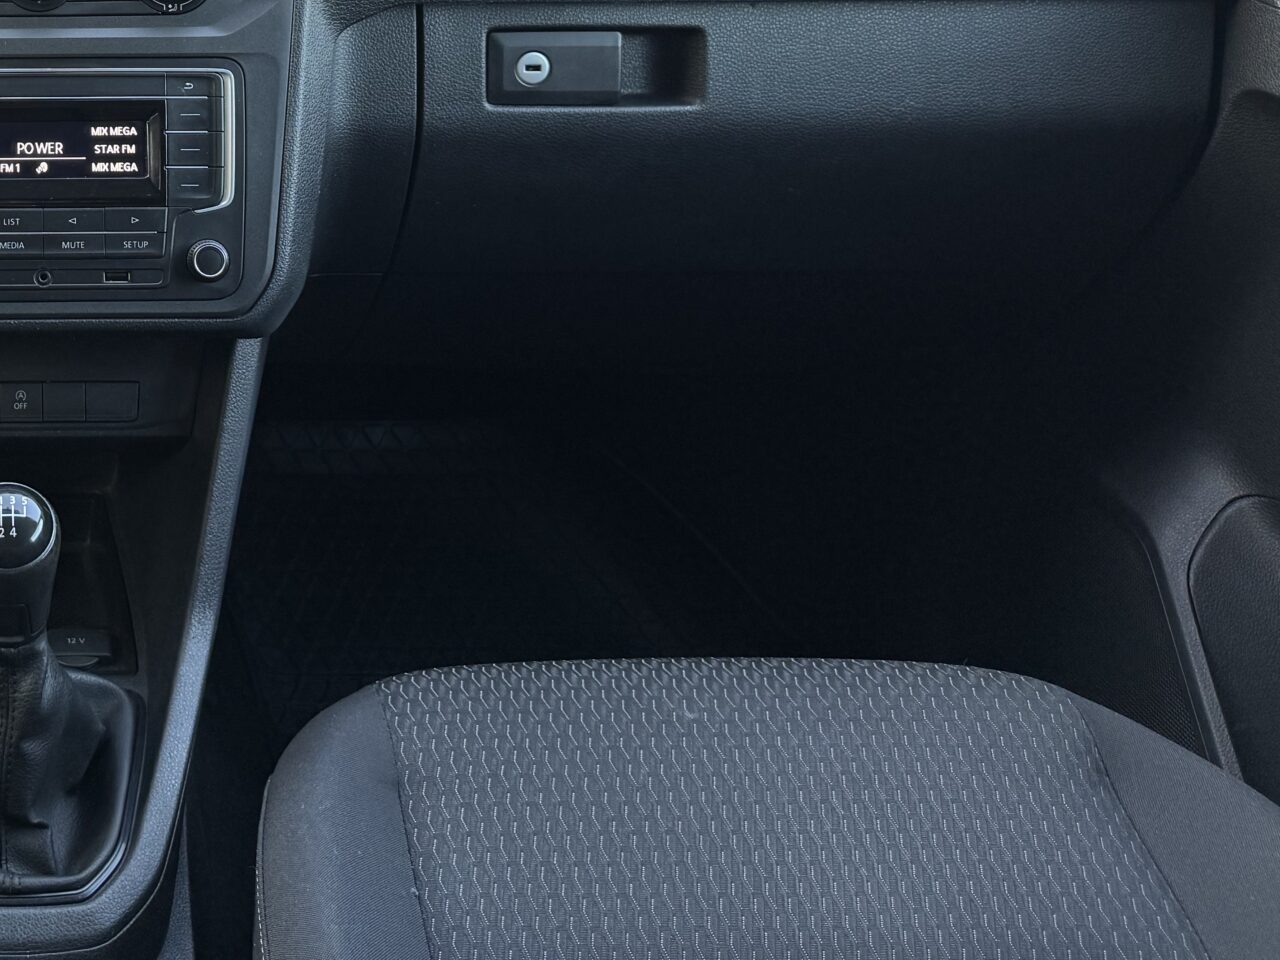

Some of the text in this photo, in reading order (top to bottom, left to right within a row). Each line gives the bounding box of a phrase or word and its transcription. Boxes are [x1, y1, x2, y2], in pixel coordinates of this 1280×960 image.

[91, 126, 138, 136] MIX MEGA
[16, 142, 64, 155] POWER
[94, 144, 136, 154] STAR FM
[0, 163, 20, 173] FM 1
[91, 162, 138, 172] MIX MEGA
[3, 218, 20, 226] LIST
[0, 241, 25, 250] MEDIA
[61, 241, 85, 249] MUTE
[123, 240, 149, 249] SETUP
[13, 402, 28, 410] OFF
[9, 495, 16, 505] 3
[21, 496, 28, 506] 5
[9, 527, 18, 538] 4
